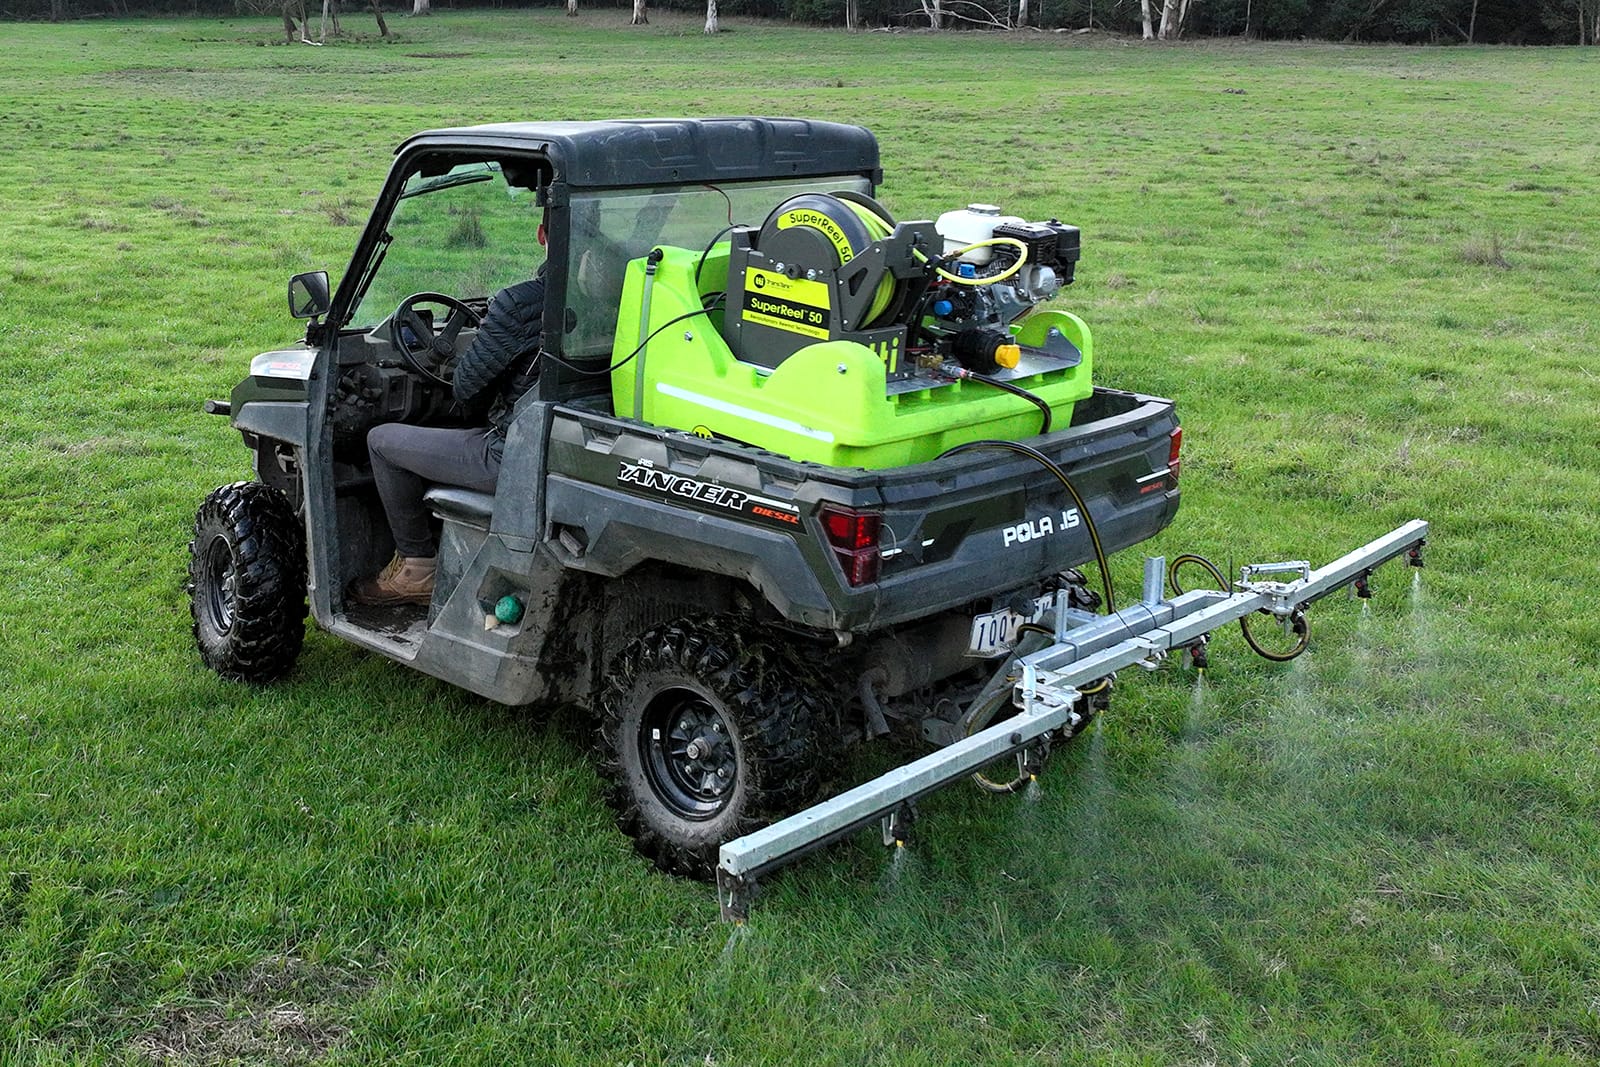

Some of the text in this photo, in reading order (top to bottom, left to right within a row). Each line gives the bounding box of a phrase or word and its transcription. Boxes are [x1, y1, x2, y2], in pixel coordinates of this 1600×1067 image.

[789, 213, 853, 263] SuperReel 50
[808, 312, 823, 324] 50
[752, 505, 799, 524] DIESEL
[1002, 507, 1080, 548] POLAIS
